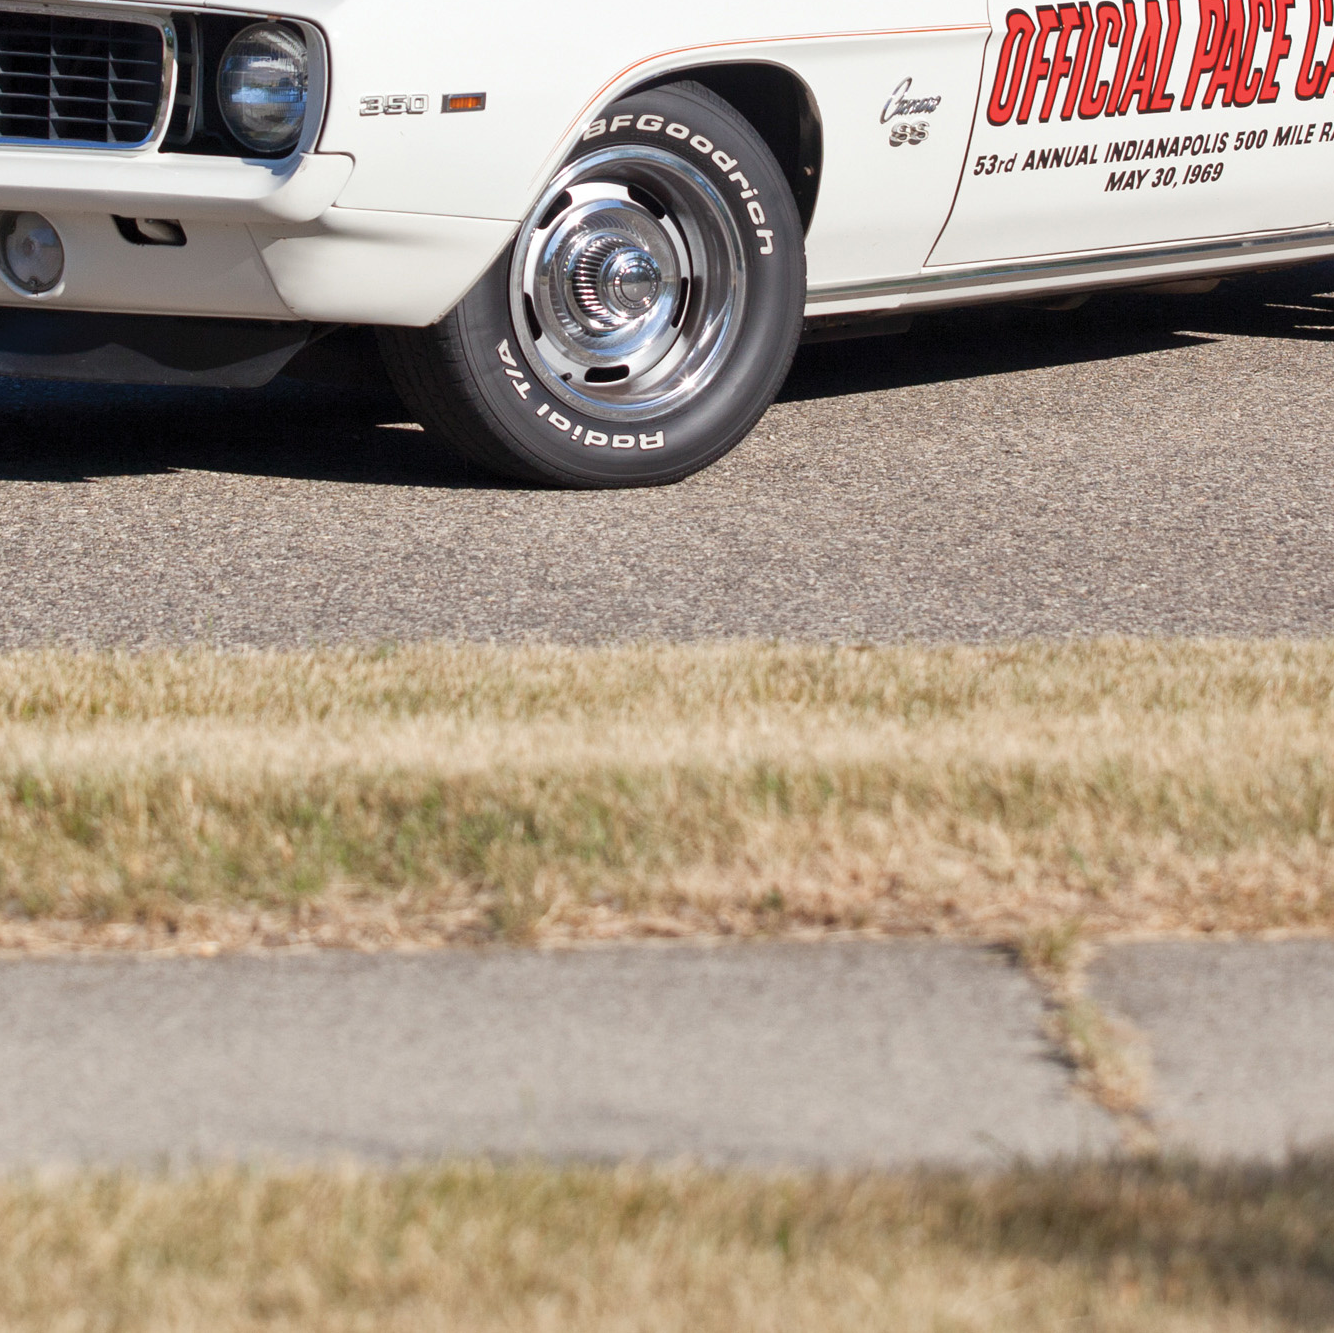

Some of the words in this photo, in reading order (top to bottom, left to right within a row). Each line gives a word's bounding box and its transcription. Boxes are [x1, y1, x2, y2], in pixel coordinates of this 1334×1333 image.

[359, 94, 429, 116] 350
[889, 120, 931, 147] SS
[973, 153, 1018, 176] 53rd
[1021, 144, 1098, 171] ANNUAL
[1103, 132, 1229, 163] INDIANAPOLIS
[1233, 129, 1269, 151] 500
[1272, 123, 1317, 147] MILE
[582, 114, 774, 256] BFGoodrich
[1104, 168, 1151, 192] MAY
[1151, 167, 1178, 189] 30,
[1182, 162, 1224, 185] 1969
[495, 338, 531, 400] T/A
[536, 403, 665, 450] Radial
